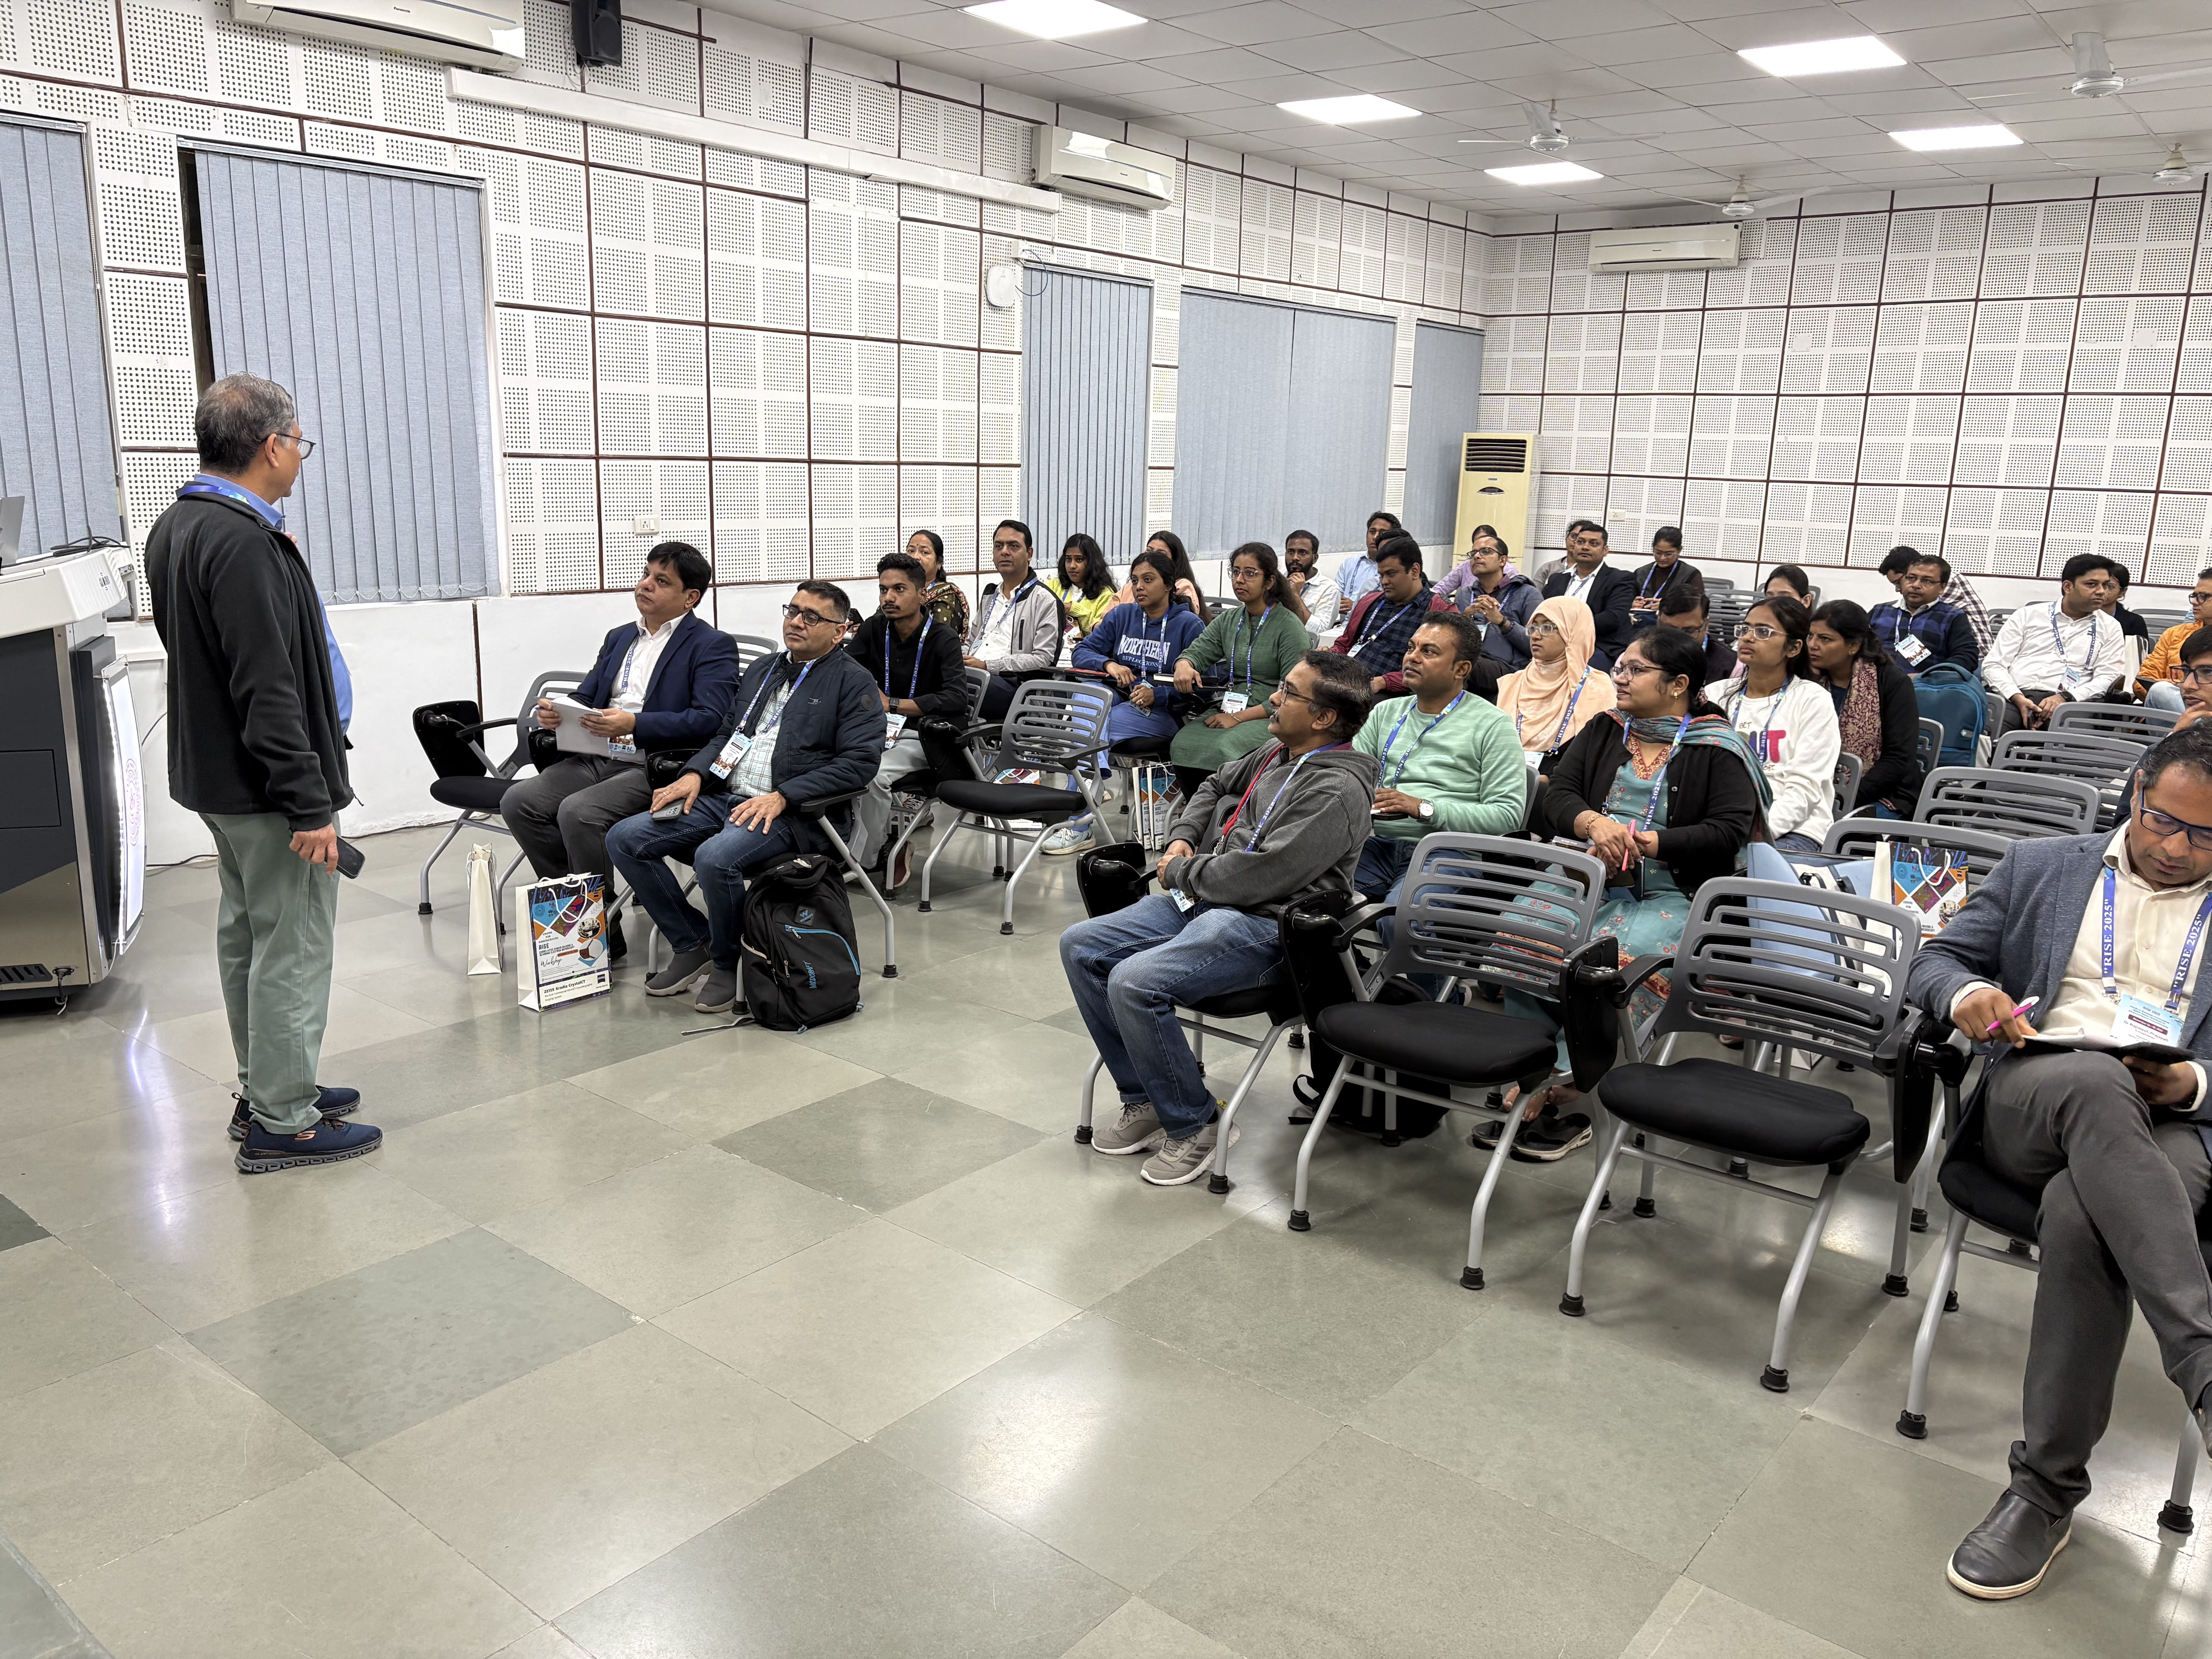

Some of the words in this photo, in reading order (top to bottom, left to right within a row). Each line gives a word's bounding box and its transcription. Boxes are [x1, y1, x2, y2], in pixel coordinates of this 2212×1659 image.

[1122, 655, 1159, 668] REFLECIONS
[1644, 803, 1656, 830] "RISE
[1652, 777, 1662, 801] 2025"
[2104, 898, 2112, 931] 2025"
[541, 956, 562, 967] Workshop
[2104, 934, 2112, 974] "RISE
[2173, 949, 2192, 988] "RISE
[2186, 914, 2202, 946] 2025"
